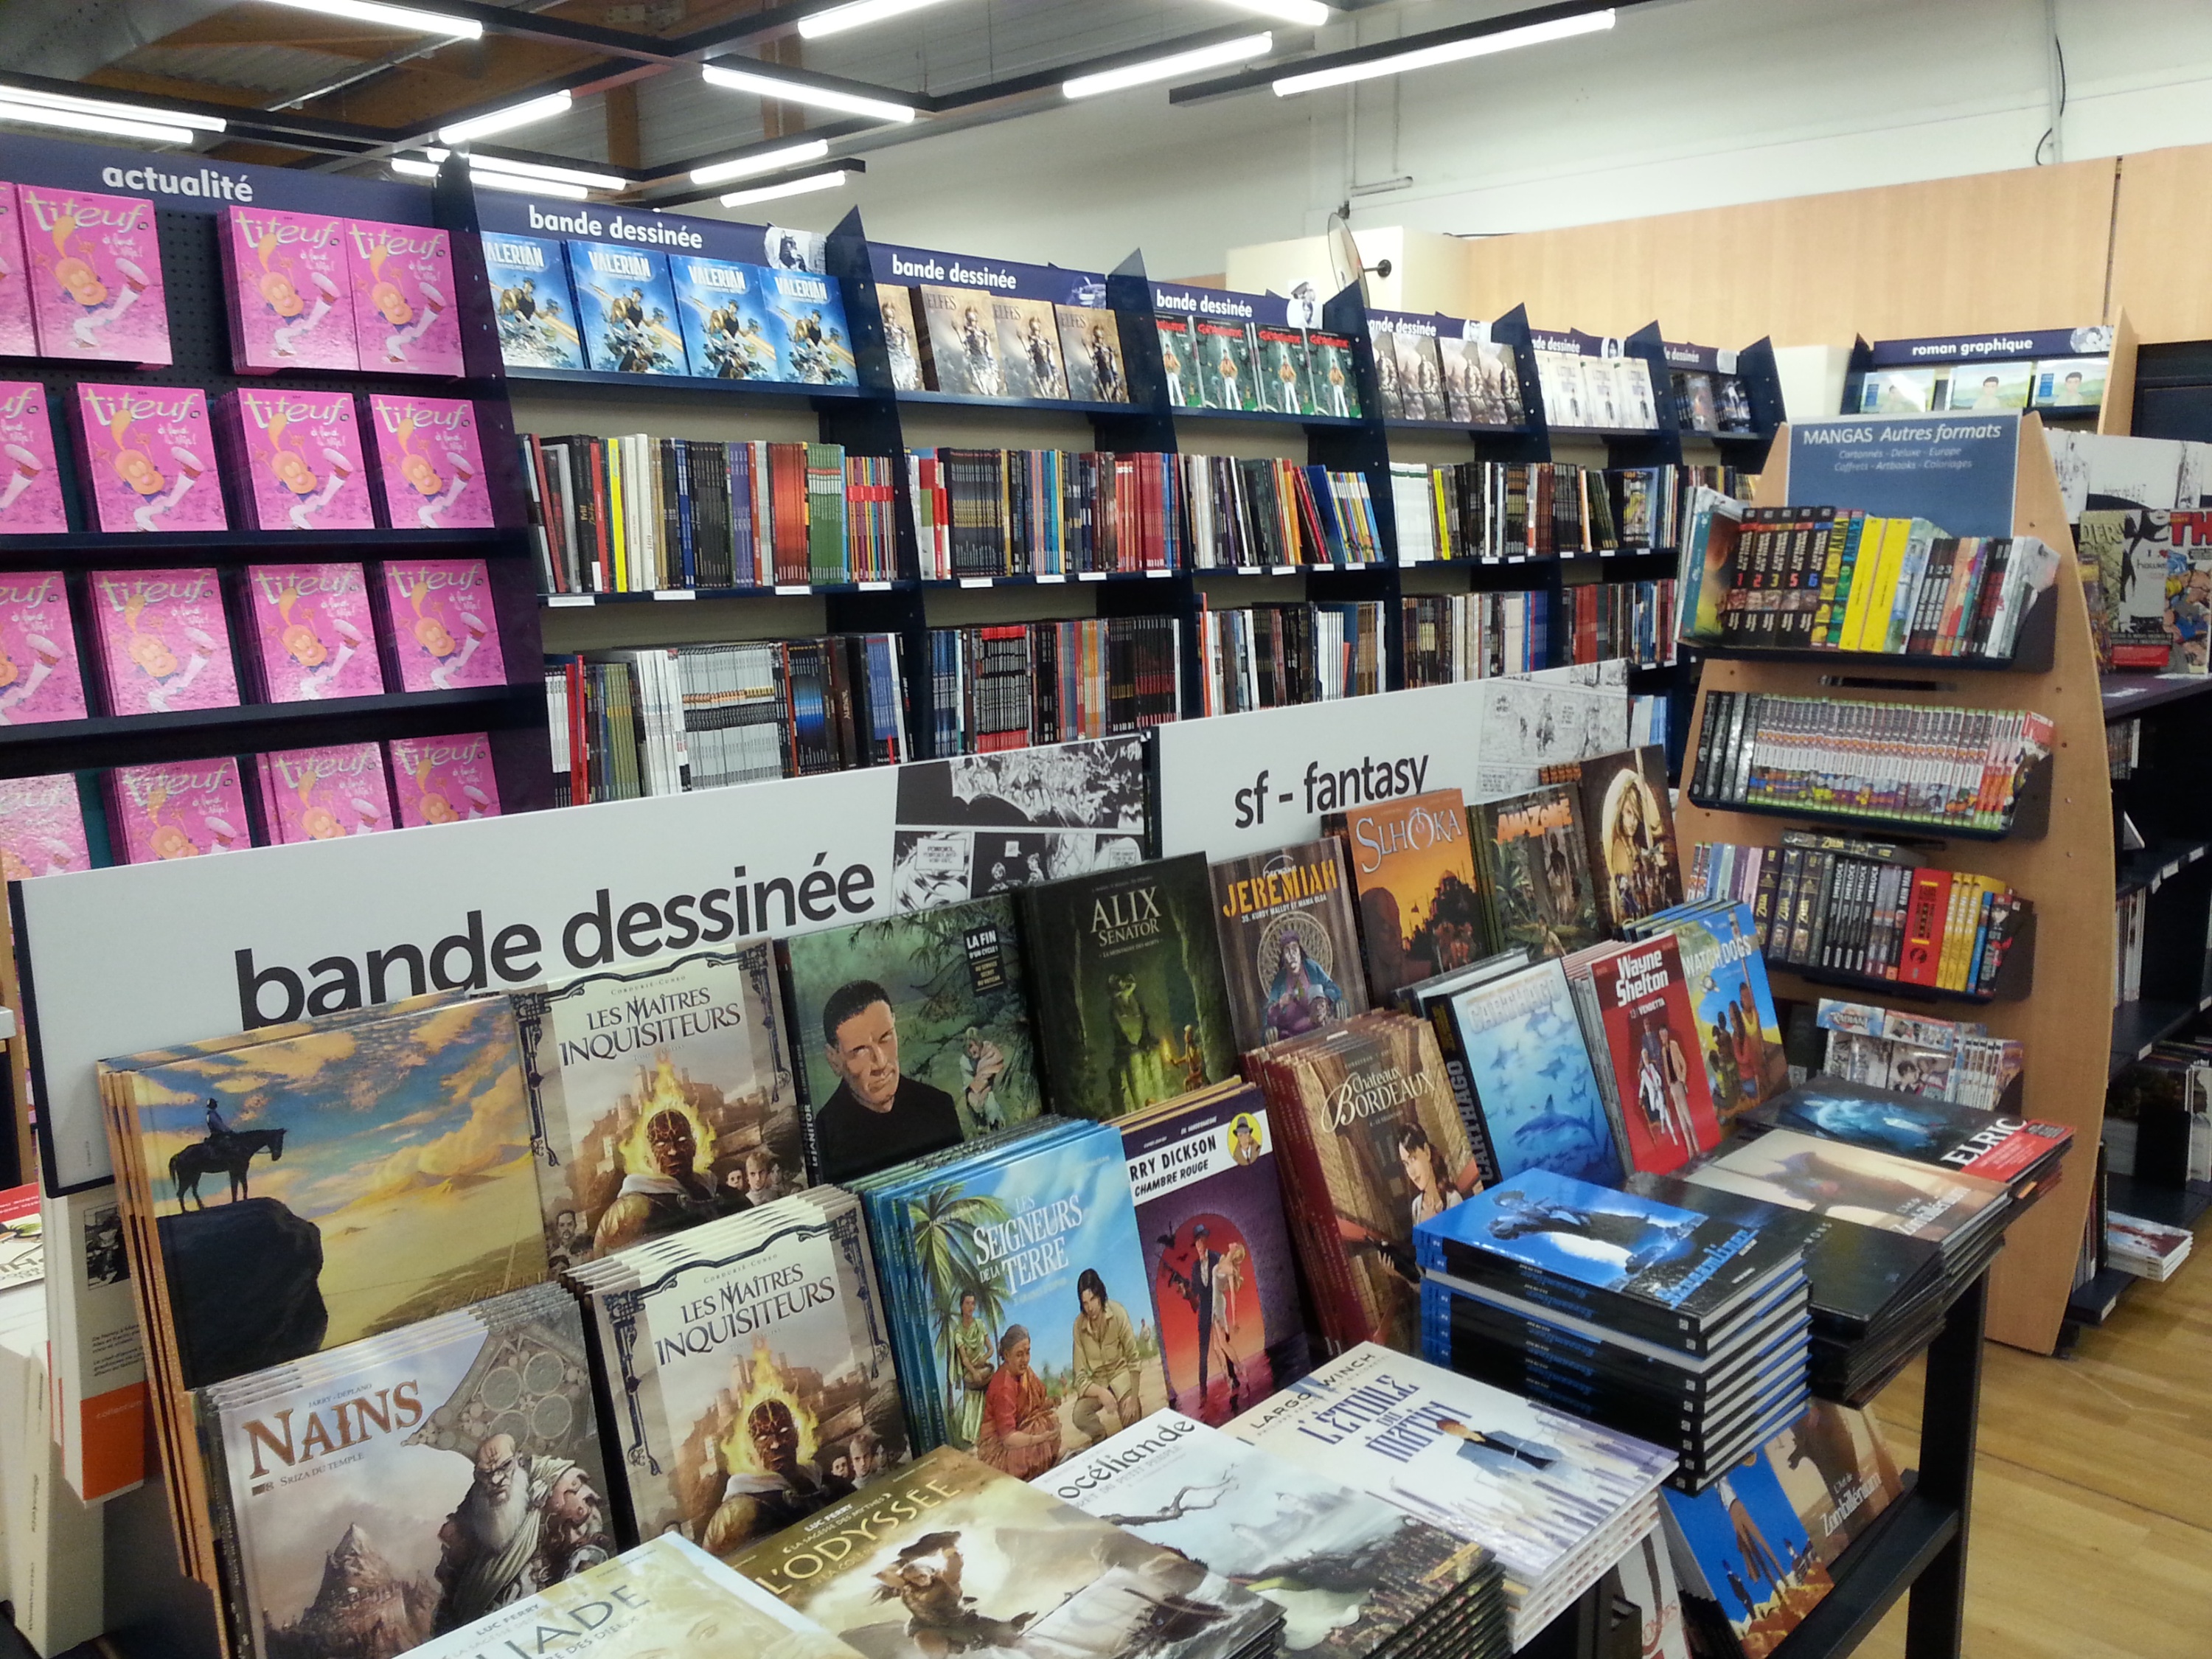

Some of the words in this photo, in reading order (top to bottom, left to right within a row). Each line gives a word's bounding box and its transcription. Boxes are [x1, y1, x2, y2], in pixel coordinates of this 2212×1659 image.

[102, 166, 254, 204] actualité
[529, 205, 602, 237] bande
[609, 216, 703, 250] dessinée
[588, 251, 652, 277] VALERIAN
[688, 265, 746, 290] VALERIAN
[892, 254, 945, 279] bande
[949, 261, 1017, 289] dessinée
[774, 276, 828, 301] VALERIAN
[1156, 289, 1197, 310] bande
[1200, 295, 1253, 319] dessinée
[1396, 318, 1437, 337] dessinée
[1547, 338, 1581, 354] dessinée
[1912, 343, 1958, 357] roman
[1960, 337, 2033, 358] graphique
[1804, 428, 1873, 445] MANGAS
[1880, 426, 1932, 442] Autres
[1933, 423, 2001, 444] formats
[1929, 447, 1962, 457] Europe
[1737, 573, 1743, 585] 1
[1753, 574, 1762, 587] 2
[1771, 574, 1779, 587] 3
[1790, 574, 1798, 587] 5
[1809, 574, 1818, 587] 6
[1234, 771, 1270, 830] sf
[1304, 754, 1429, 815] fantasy
[1356, 807, 1462, 874] SLHOKA
[1222, 859, 1338, 917] JEREMIAH
[1091, 886, 1162, 933] ALIX
[233, 908, 541, 1032] bande
[560, 852, 874, 970] dessinée
[967, 935, 979, 950] LA
[981, 930, 997, 945] FIN
[1099, 918, 1160, 947] SENATOR
[1617, 950, 1663, 982] Wayne
[1467, 975, 1562, 1032] CARTHAGO
[1615, 970, 1669, 1007] Shelton
[587, 1007, 622, 1030] LES
[626, 987, 712, 1026] MAÎTRES
[1638, 998, 1665, 1016] VENDETTA
[559, 1003, 742, 1066] INQUISITEURS
[1352, 1066, 1401, 1093] Châteaux
[1321, 1071, 1435, 1133] BORDEAUX
[1446, 1060, 1493, 1180] CARTHAGO
[1130, 1158, 1155, 1181] RRY
[1161, 1135, 1217, 1169] DICKSON
[1940, 1118, 2028, 1166] ELRIC
[1135, 1172, 1178, 1197] CHAMBRE
[1180, 1159, 1208, 1180] ROUGE
[1015, 1196, 1035, 1214] LES
[973, 1194, 1082, 1265] SEIGNEURS
[980, 1269, 990, 1284] DE
[990, 1266, 1000, 1279] LA
[1001, 1237, 1068, 1295] TERRE
[681, 1296, 715, 1324] LES
[718, 1264, 804, 1307] MAÎTRES
[654, 1276, 835, 1365] INQUISITEURS
[338, 1383, 372, 1399] DEPLANO
[1250, 1392, 1312, 1429] LARGO
[1317, 1354, 1376, 1387] WINCH
[242, 1380, 422, 1480] NAINS
[280, 1472, 310, 1487] SRIZA
[312, 1467, 325, 1477] DU
[328, 1452, 365, 1471] TEMPLE
[1057, 1420, 1195, 1499] océliande
[804, 1517, 824, 1533] LUC
[825, 1503, 853, 1522] FERRY
[754, 1479, 961, 1595] L'ODYSSÉE
[476, 1621, 501, 1636] LUC
[503, 1604, 539, 1623] FERRY
[566, 1638, 593, 1654] DES
[595, 1615, 640, 1640] DIEUX
